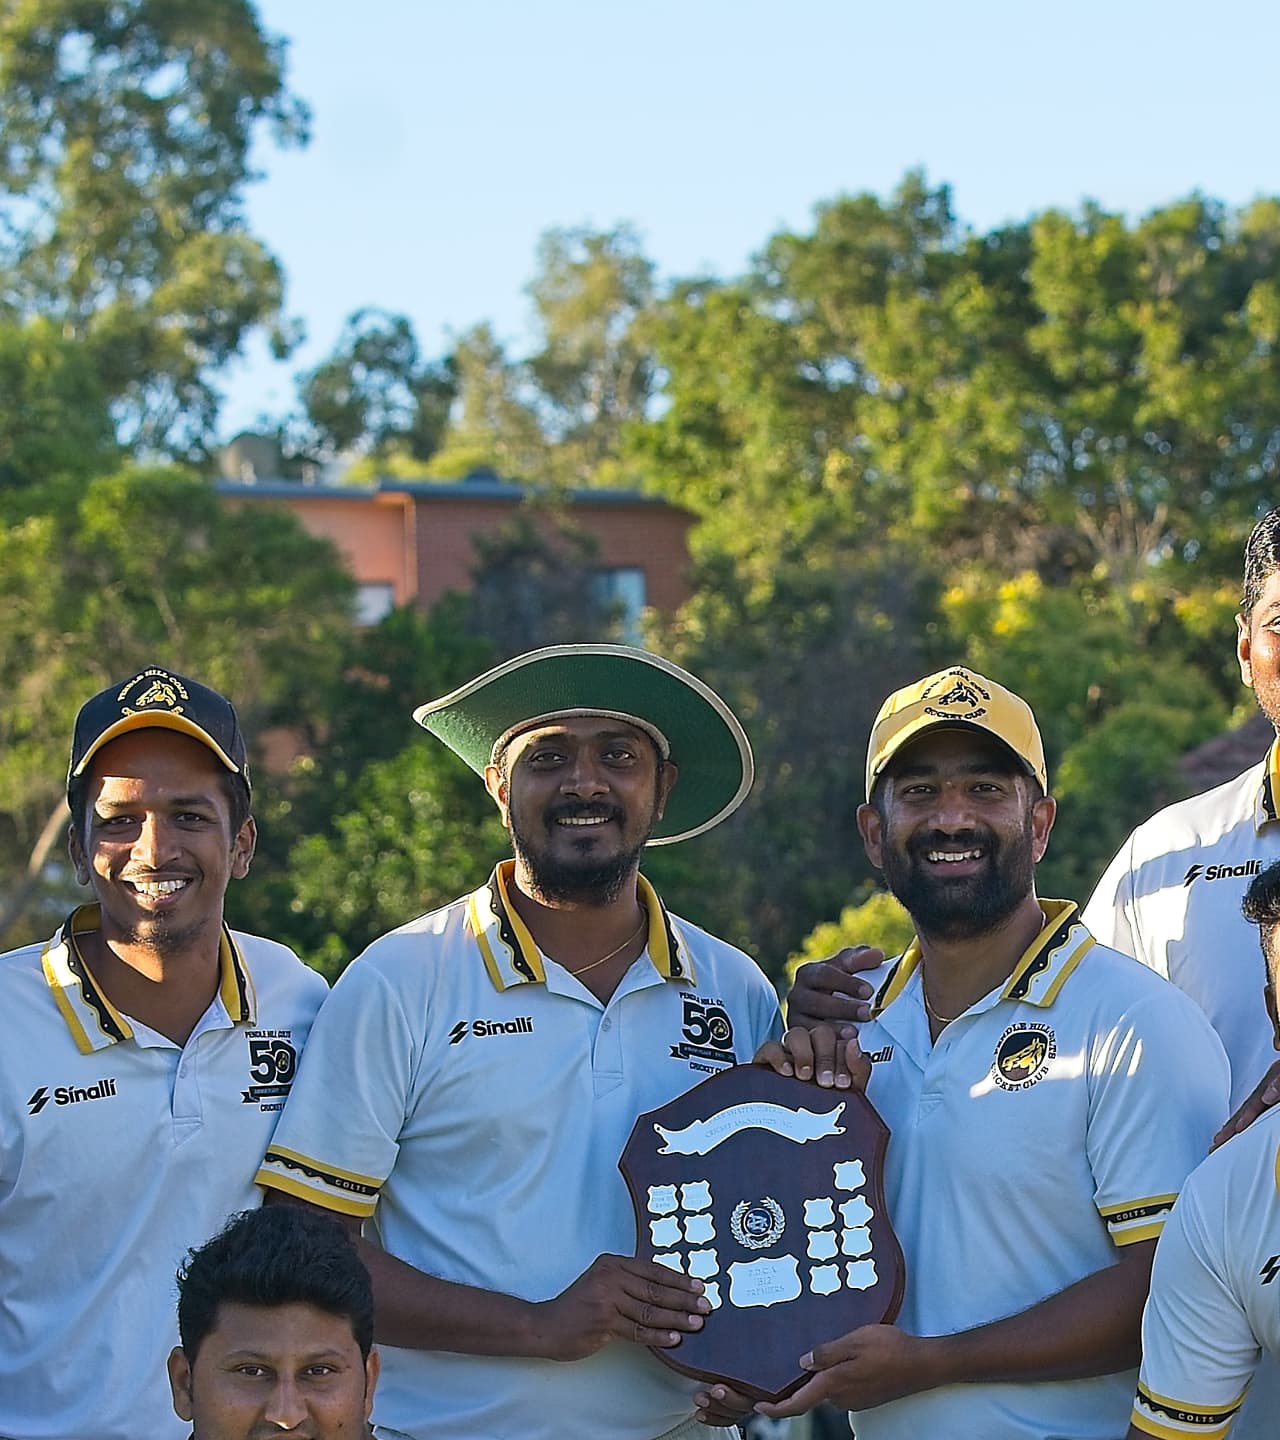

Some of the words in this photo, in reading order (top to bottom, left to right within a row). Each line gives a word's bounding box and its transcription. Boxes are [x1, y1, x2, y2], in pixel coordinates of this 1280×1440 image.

[1205, 860, 1263, 881] Sinalli
[472, 1016, 535, 1037] Sinalli
[682, 1000, 734, 1050] 50
[1028, 1022, 1051, 1035] HILL
[249, 1040, 296, 1084] 50
[1022, 1065, 1049, 1089] CLUB
[54, 1078, 118, 1106] Sinalli
[1116, 1209, 1147, 1221] COLTS
[1177, 1412, 1215, 1423] COLTS
